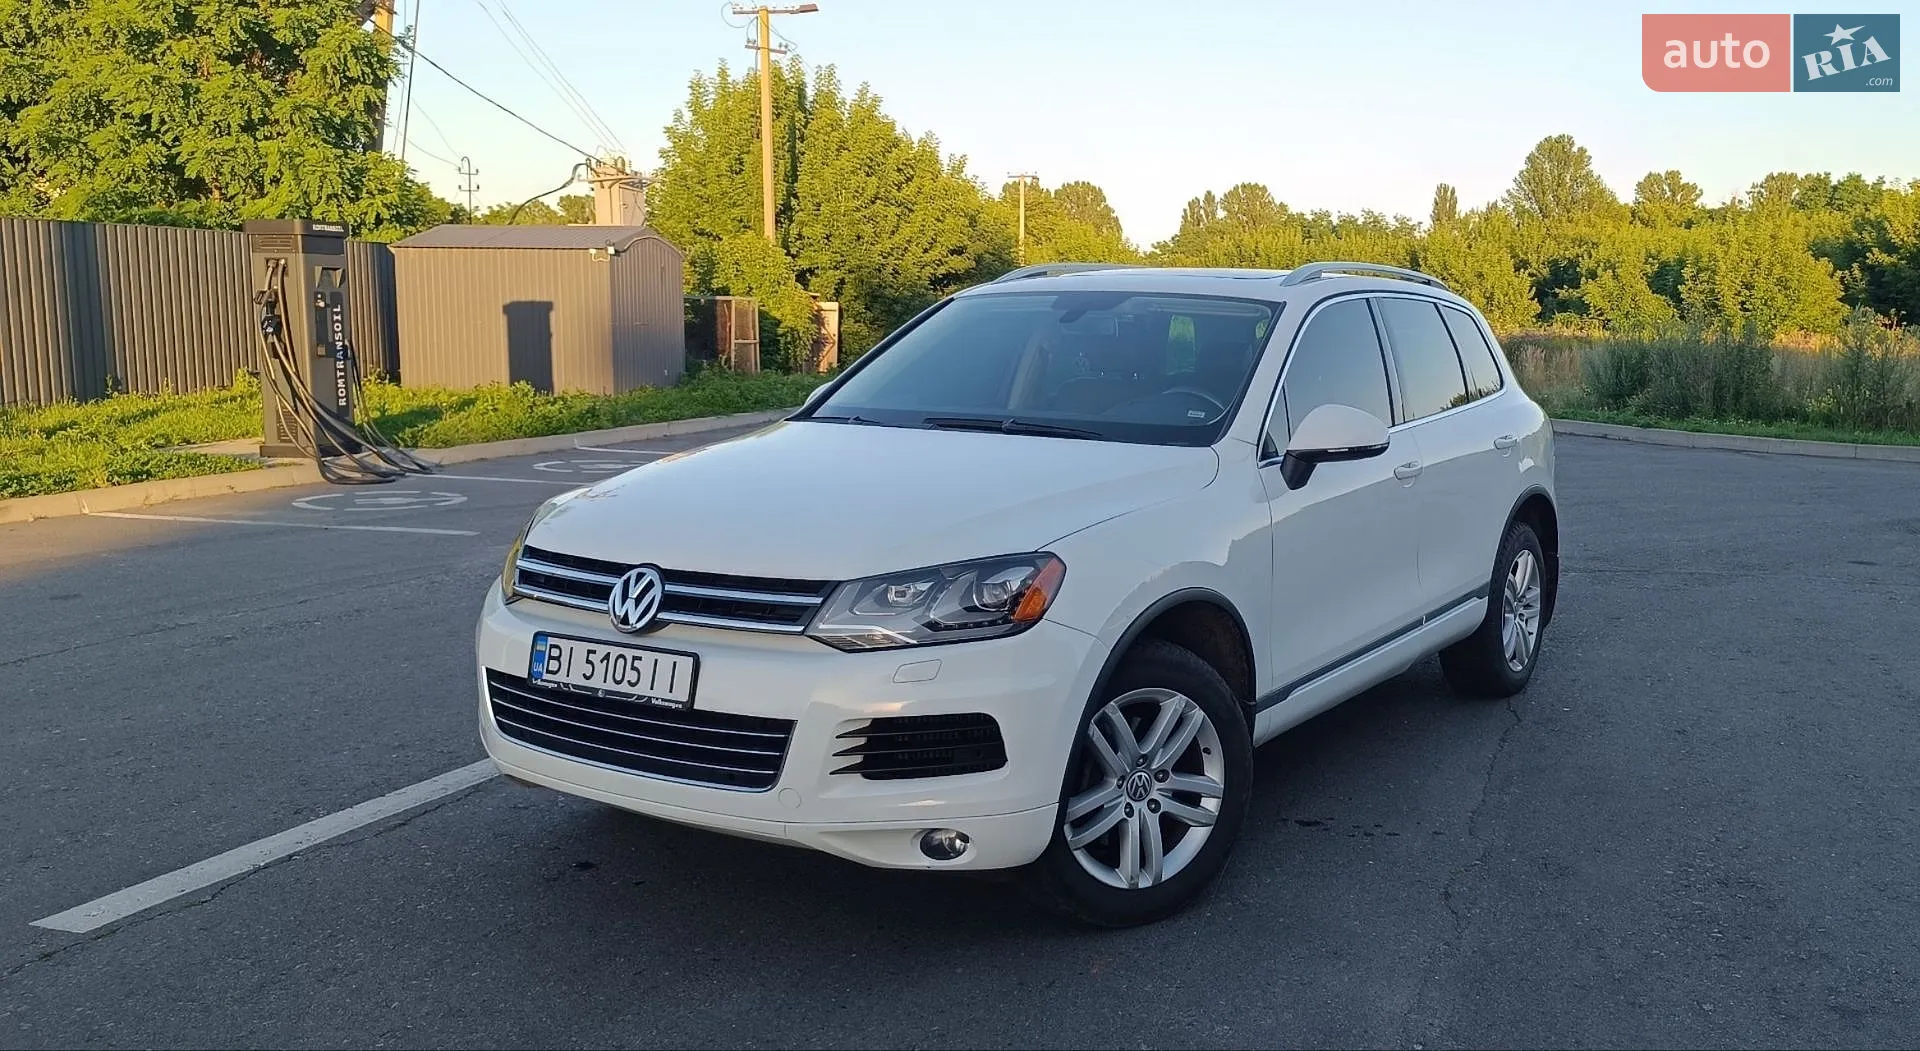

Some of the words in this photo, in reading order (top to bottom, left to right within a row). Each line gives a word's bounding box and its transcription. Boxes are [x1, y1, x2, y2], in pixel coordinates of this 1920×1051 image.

[333, 304, 347, 406] ROMTRANSOIL
[533, 662, 543, 673] UA
[545, 643, 574, 678] BI
[582, 649, 643, 688] 5105
[650, 658, 677, 693] II
